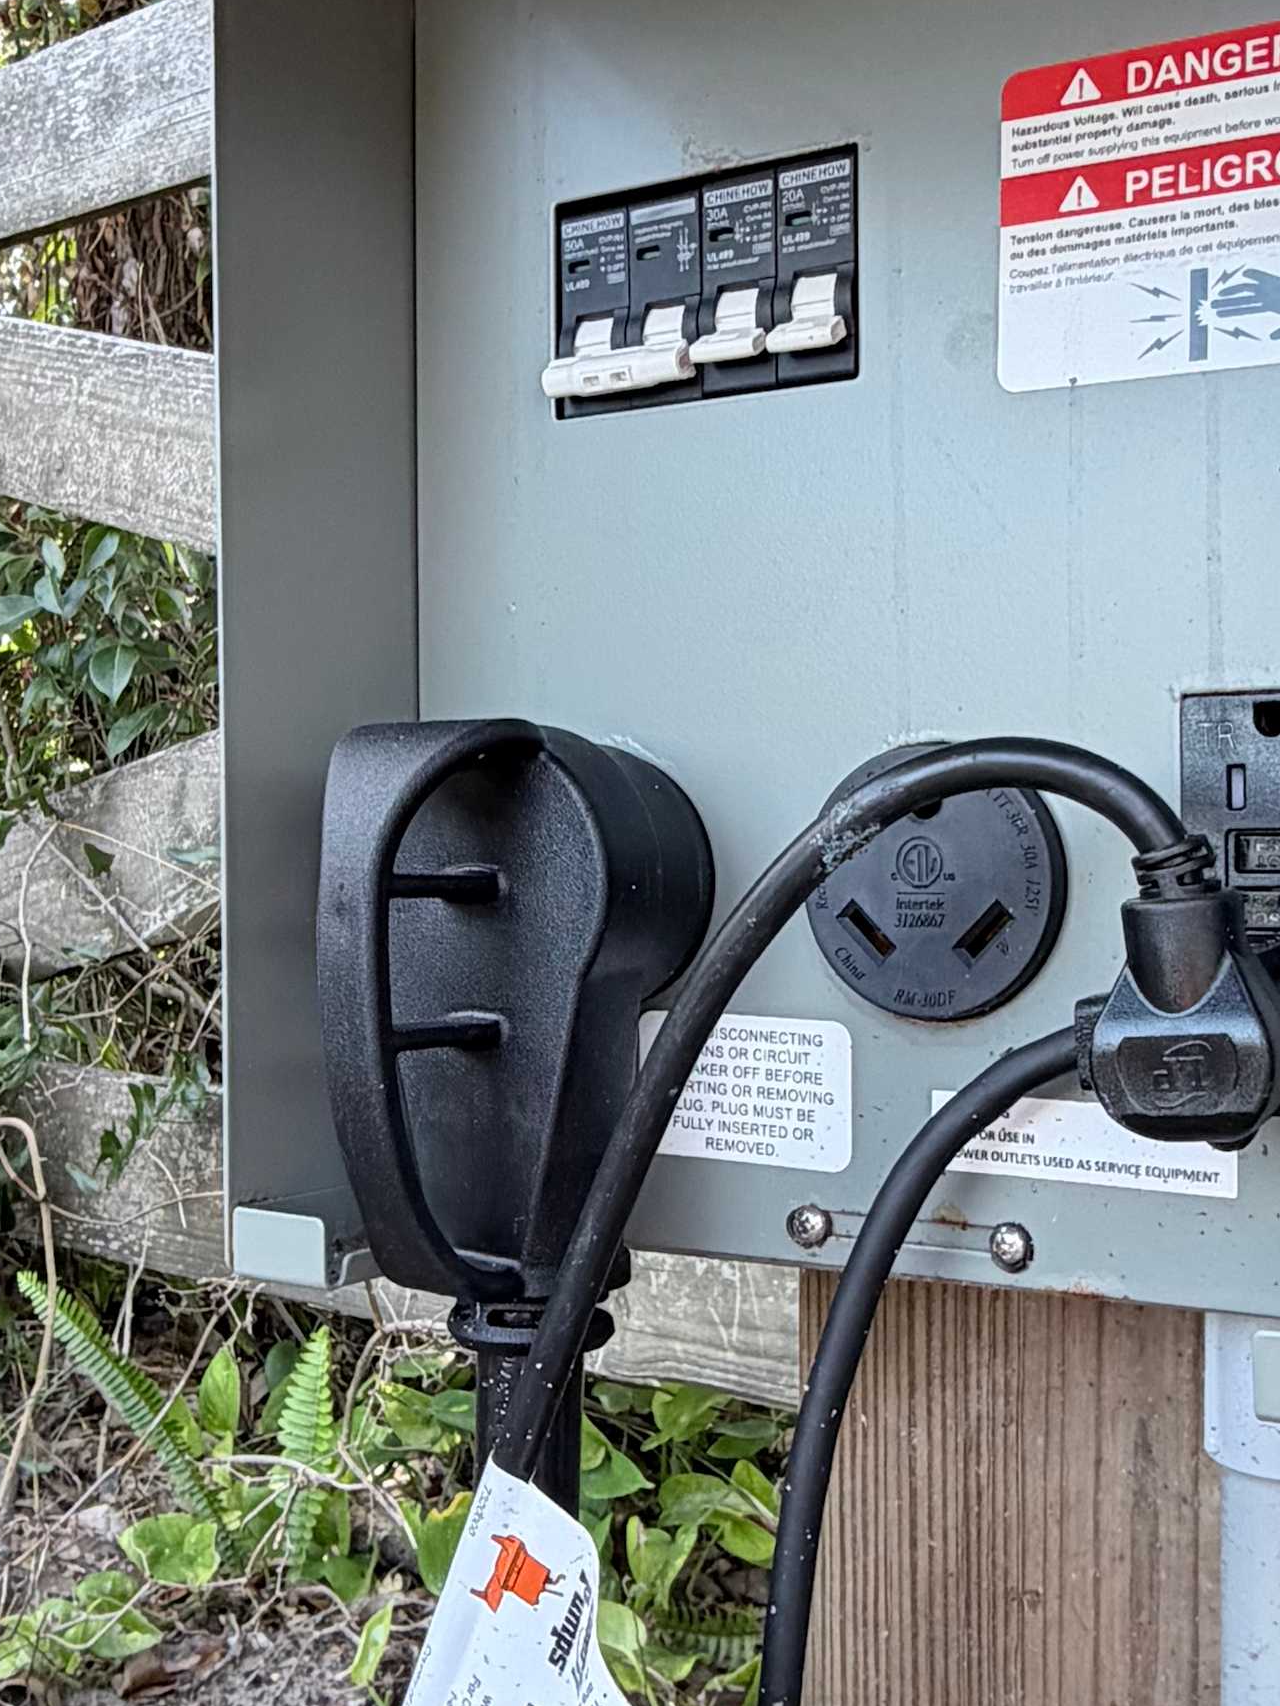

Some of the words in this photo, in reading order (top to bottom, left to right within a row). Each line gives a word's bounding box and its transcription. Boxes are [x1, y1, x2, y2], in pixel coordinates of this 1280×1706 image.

[1011, 119, 1070, 137] Hazardous
[1072, 111, 1118, 126] Voltage.
[1120, 104, 1143, 118] Will
[1145, 100, 1181, 114] cause
[1183, 91, 1221, 107] death,
[1223, 84, 1269, 100] serious
[1010, 132, 1072, 153] substantial
[1074, 124, 1123, 144] property
[1125, 116, 1175, 133] damage.
[1010, 157, 1034, 169] Turn
[1035, 152, 1051, 165] off
[1052, 148, 1085, 165] power
[1087, 139, 1139, 157] supplying
[1140, 134, 1160, 147] this
[1162, 123, 1222, 144] equipment
[1224, 118, 1261, 134] before
[781, 162, 847, 185] CHINEHOW
[781, 187, 805, 204] 20A
[705, 206, 728, 222] 30A
[1009, 231, 1053, 246] Tension
[1055, 221, 1125, 239] dangereuse.
[1127, 212, 1177, 228] Causera
[1179, 209, 1190, 221] la
[1192, 204, 1225, 219] mort,
[1227, 201, 1250, 213] des
[1009, 250, 1024, 261] ou
[1026, 247, 1047, 258] des
[1048, 237, 1111, 255] dommages
[1170, 219, 1238, 237] importants.
[1200, 723, 1237, 749] TR
[896, 897, 945, 911] Intertek
[894, 913, 945, 928] 3126867
[834, 947, 866, 981] China
[727, 1045, 749, 1060] OR
[752, 1047, 811, 1065] CIRCUIT
[731, 1064, 760, 1079] OFF
[764, 1067, 823, 1086] BEFORE
[730, 1083, 752, 1098] OR
[756, 1085, 834, 1106] REMOVING
[710, 1099, 749, 1116] PLUG
[752, 1103, 792, 1120] MUST
[796, 1107, 815, 1123] BE
[669, 1113, 714, 1131] FULLY
[717, 1118, 788, 1139] INSERTED
[791, 1126, 814, 1142] OR
[976, 1131, 994, 1141] OR
[997, 1129, 1019, 1143] USE
[1021, 1132, 1035, 1144] IN
[704, 1135, 779, 1157] REMOVED.
[990, 1149, 1040, 1166] OUTLETS
[1042, 1155, 1074, 1169] USED
[1075, 1158, 1092, 1171] AS
[1093, 1160, 1141, 1177] SERVICE
[466, 1672, 482, 1698] For
